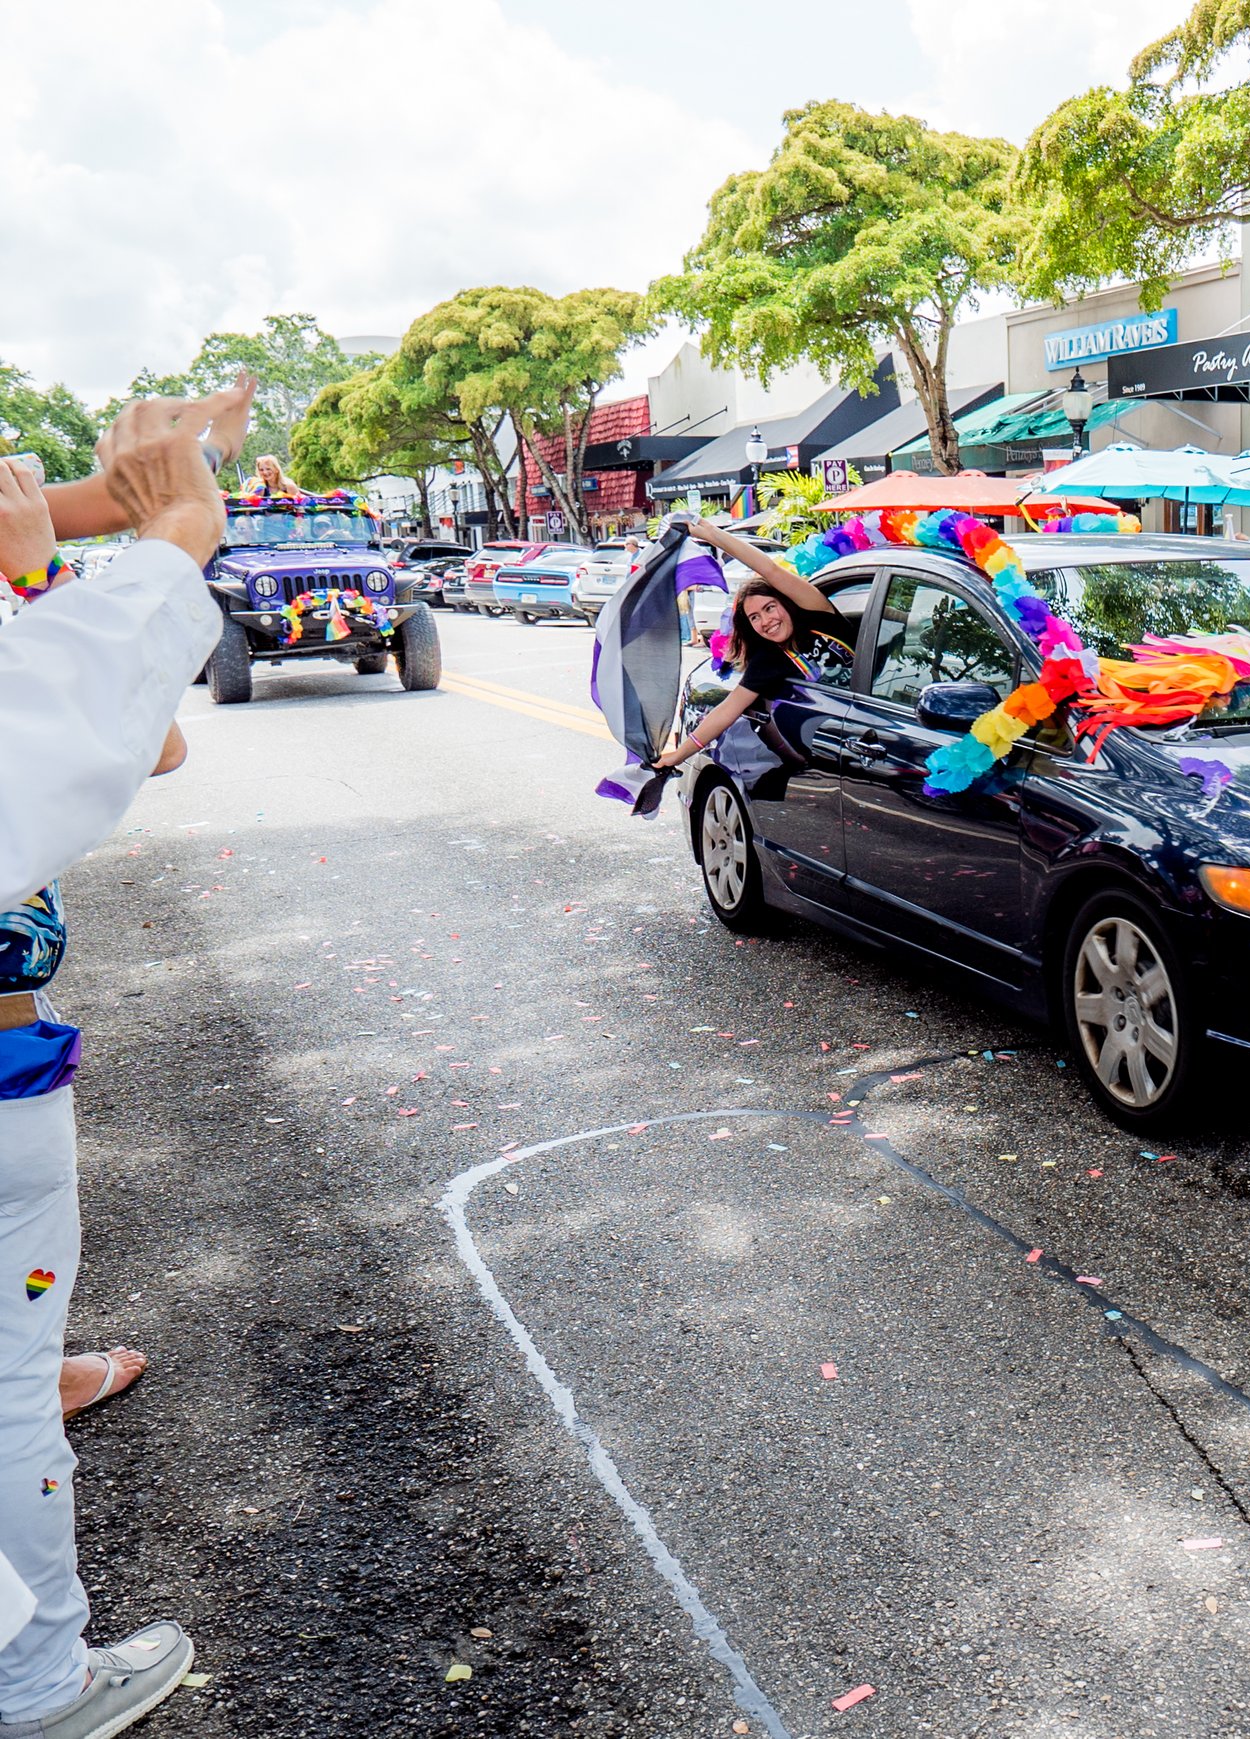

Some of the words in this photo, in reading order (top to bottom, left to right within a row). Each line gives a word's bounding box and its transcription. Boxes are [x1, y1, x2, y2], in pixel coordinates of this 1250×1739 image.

[1044, 328, 1112, 363] WILLIAM
[1109, 319, 1168, 350] RAVEIS
[1192, 350, 1238, 382] Pastry
[826, 460, 842, 468] PAY
[826, 484, 847, 492] HERE
[313, 568, 330, 576] Jeep
